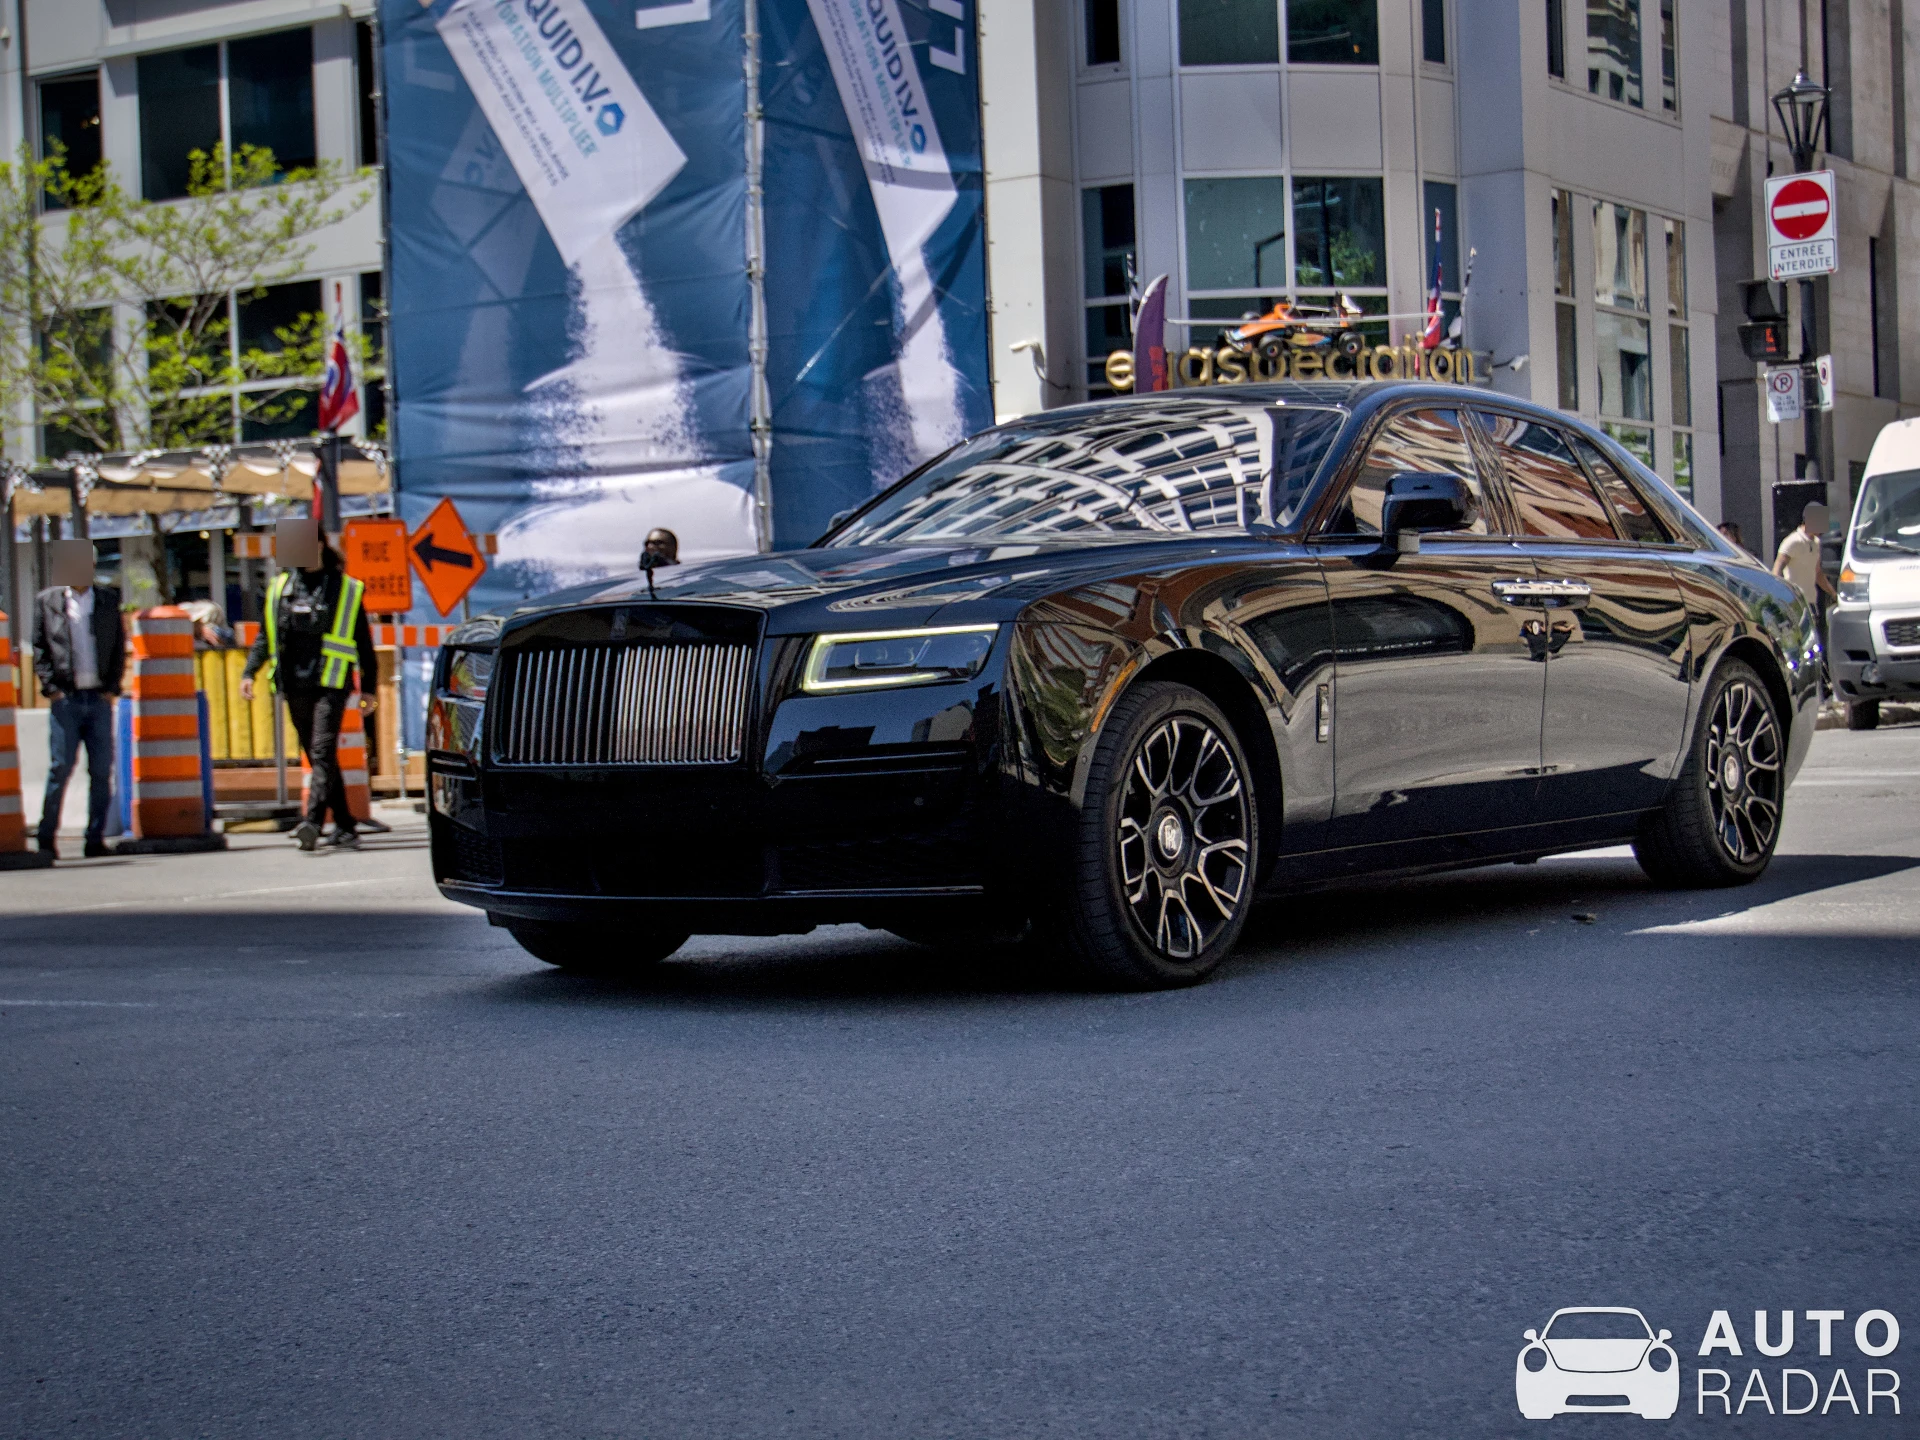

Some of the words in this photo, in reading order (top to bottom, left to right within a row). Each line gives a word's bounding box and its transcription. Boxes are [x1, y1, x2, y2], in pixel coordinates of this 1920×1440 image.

[570, 62, 611, 112] I.V.
[537, 68, 601, 158] MULTIPLIER
[1780, 243, 1825, 259] ENTRÉE
[1773, 257, 1832, 272] INTERDITE
[361, 540, 391, 563] RUE
